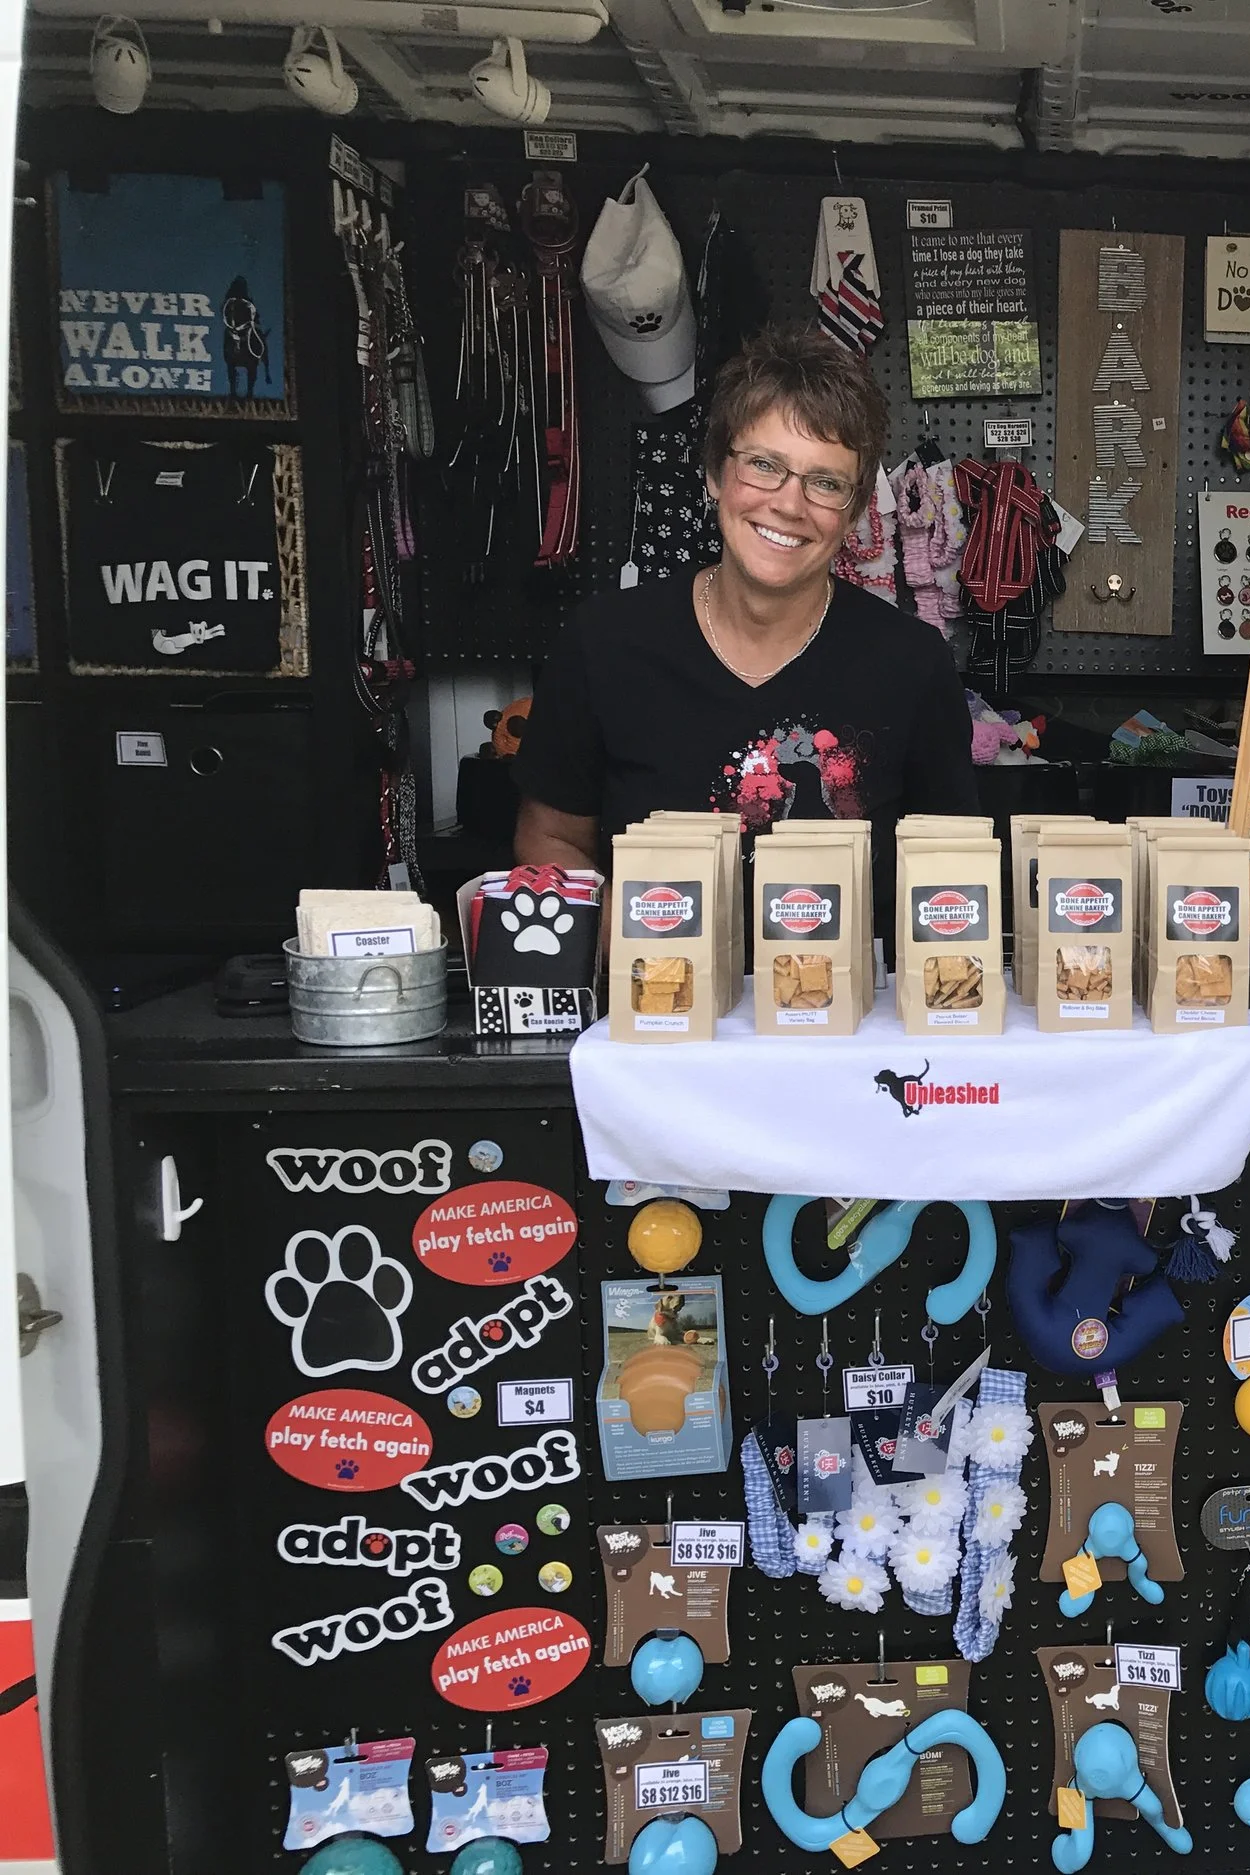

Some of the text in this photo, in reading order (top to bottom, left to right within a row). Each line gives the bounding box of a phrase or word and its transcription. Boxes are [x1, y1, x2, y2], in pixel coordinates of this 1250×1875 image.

[911, 204, 948, 212] Framed Print
[920, 213, 937, 224] $10
[912, 232, 1023, 247] It came to me that every
[912, 250, 931, 262] time
[940, 248, 957, 260] lose
[960, 250, 964, 260] a
[967, 247, 982, 262] dog
[984, 247, 1002, 261] they
[1005, 246, 1024, 258] take
[1226, 260, 1249, 280] No
[914, 279, 936, 288] and
[940, 278, 972, 287] every
[1004, 277, 1026, 286] dog
[60, 289, 215, 318] NEVER
[917, 299, 1027, 318] a piece of their heart.
[60, 321, 212, 362] WALK
[64, 364, 212, 391] ALONE
[1088, 246, 1150, 543] BARK
[101, 559, 212, 604] WAG
[657, 901, 689, 909] APPETIT
[774, 903, 827, 912] BONE APPETIT
[923, 905, 974, 913] BONE APPETIT
[1060, 897, 1079, 905] BONE
[1060, 904, 1110, 912] CANINE BAKERY
[1178, 905, 1226, 913] BONE APPETIT
[799, 911, 827, 919] BAKERY
[1178, 913, 1201, 921] CANINE
[355, 935, 390, 947] Coaster
[568, 1017, 576, 1025] $3
[905, 1082, 999, 1105] Unleashed
[269, 1141, 449, 1191] woof
[430, 1195, 553, 1223] MAKE AMERICA
[418, 1216, 576, 1256] play fetch again
[414, 1278, 569, 1391] adopt
[852, 1371, 905, 1382] Daisy Collar
[515, 1385, 556, 1397] Magnets
[867, 1389, 893, 1406] $10
[288, 1405, 413, 1428] MAKE AMERICA
[525, 1400, 545, 1416] $4
[270, 1427, 430, 1459] play fetch again
[802, 1430, 810, 1465] HUXLEY
[404, 1433, 577, 1509] woof
[1134, 1463, 1155, 1472] TIZZI
[802, 1477, 810, 1502] KENT
[699, 1528, 717, 1537] Jive
[281, 1518, 457, 1573] adopt
[678, 1543, 737, 1560] $8 $12 $16
[687, 1570, 707, 1578] JIVE
[275, 1580, 450, 1663] woof
[446, 1615, 564, 1659] MAKE AMERICA
[438, 1634, 588, 1692] play fetch again
[1138, 1650, 1155, 1660] Tizzi
[1127, 1664, 1170, 1683] $14 $20
[1138, 1703, 1156, 1713] TIZZI
[662, 1769, 680, 1779] Jive
[642, 1784, 702, 1805] $8 $12 $16
